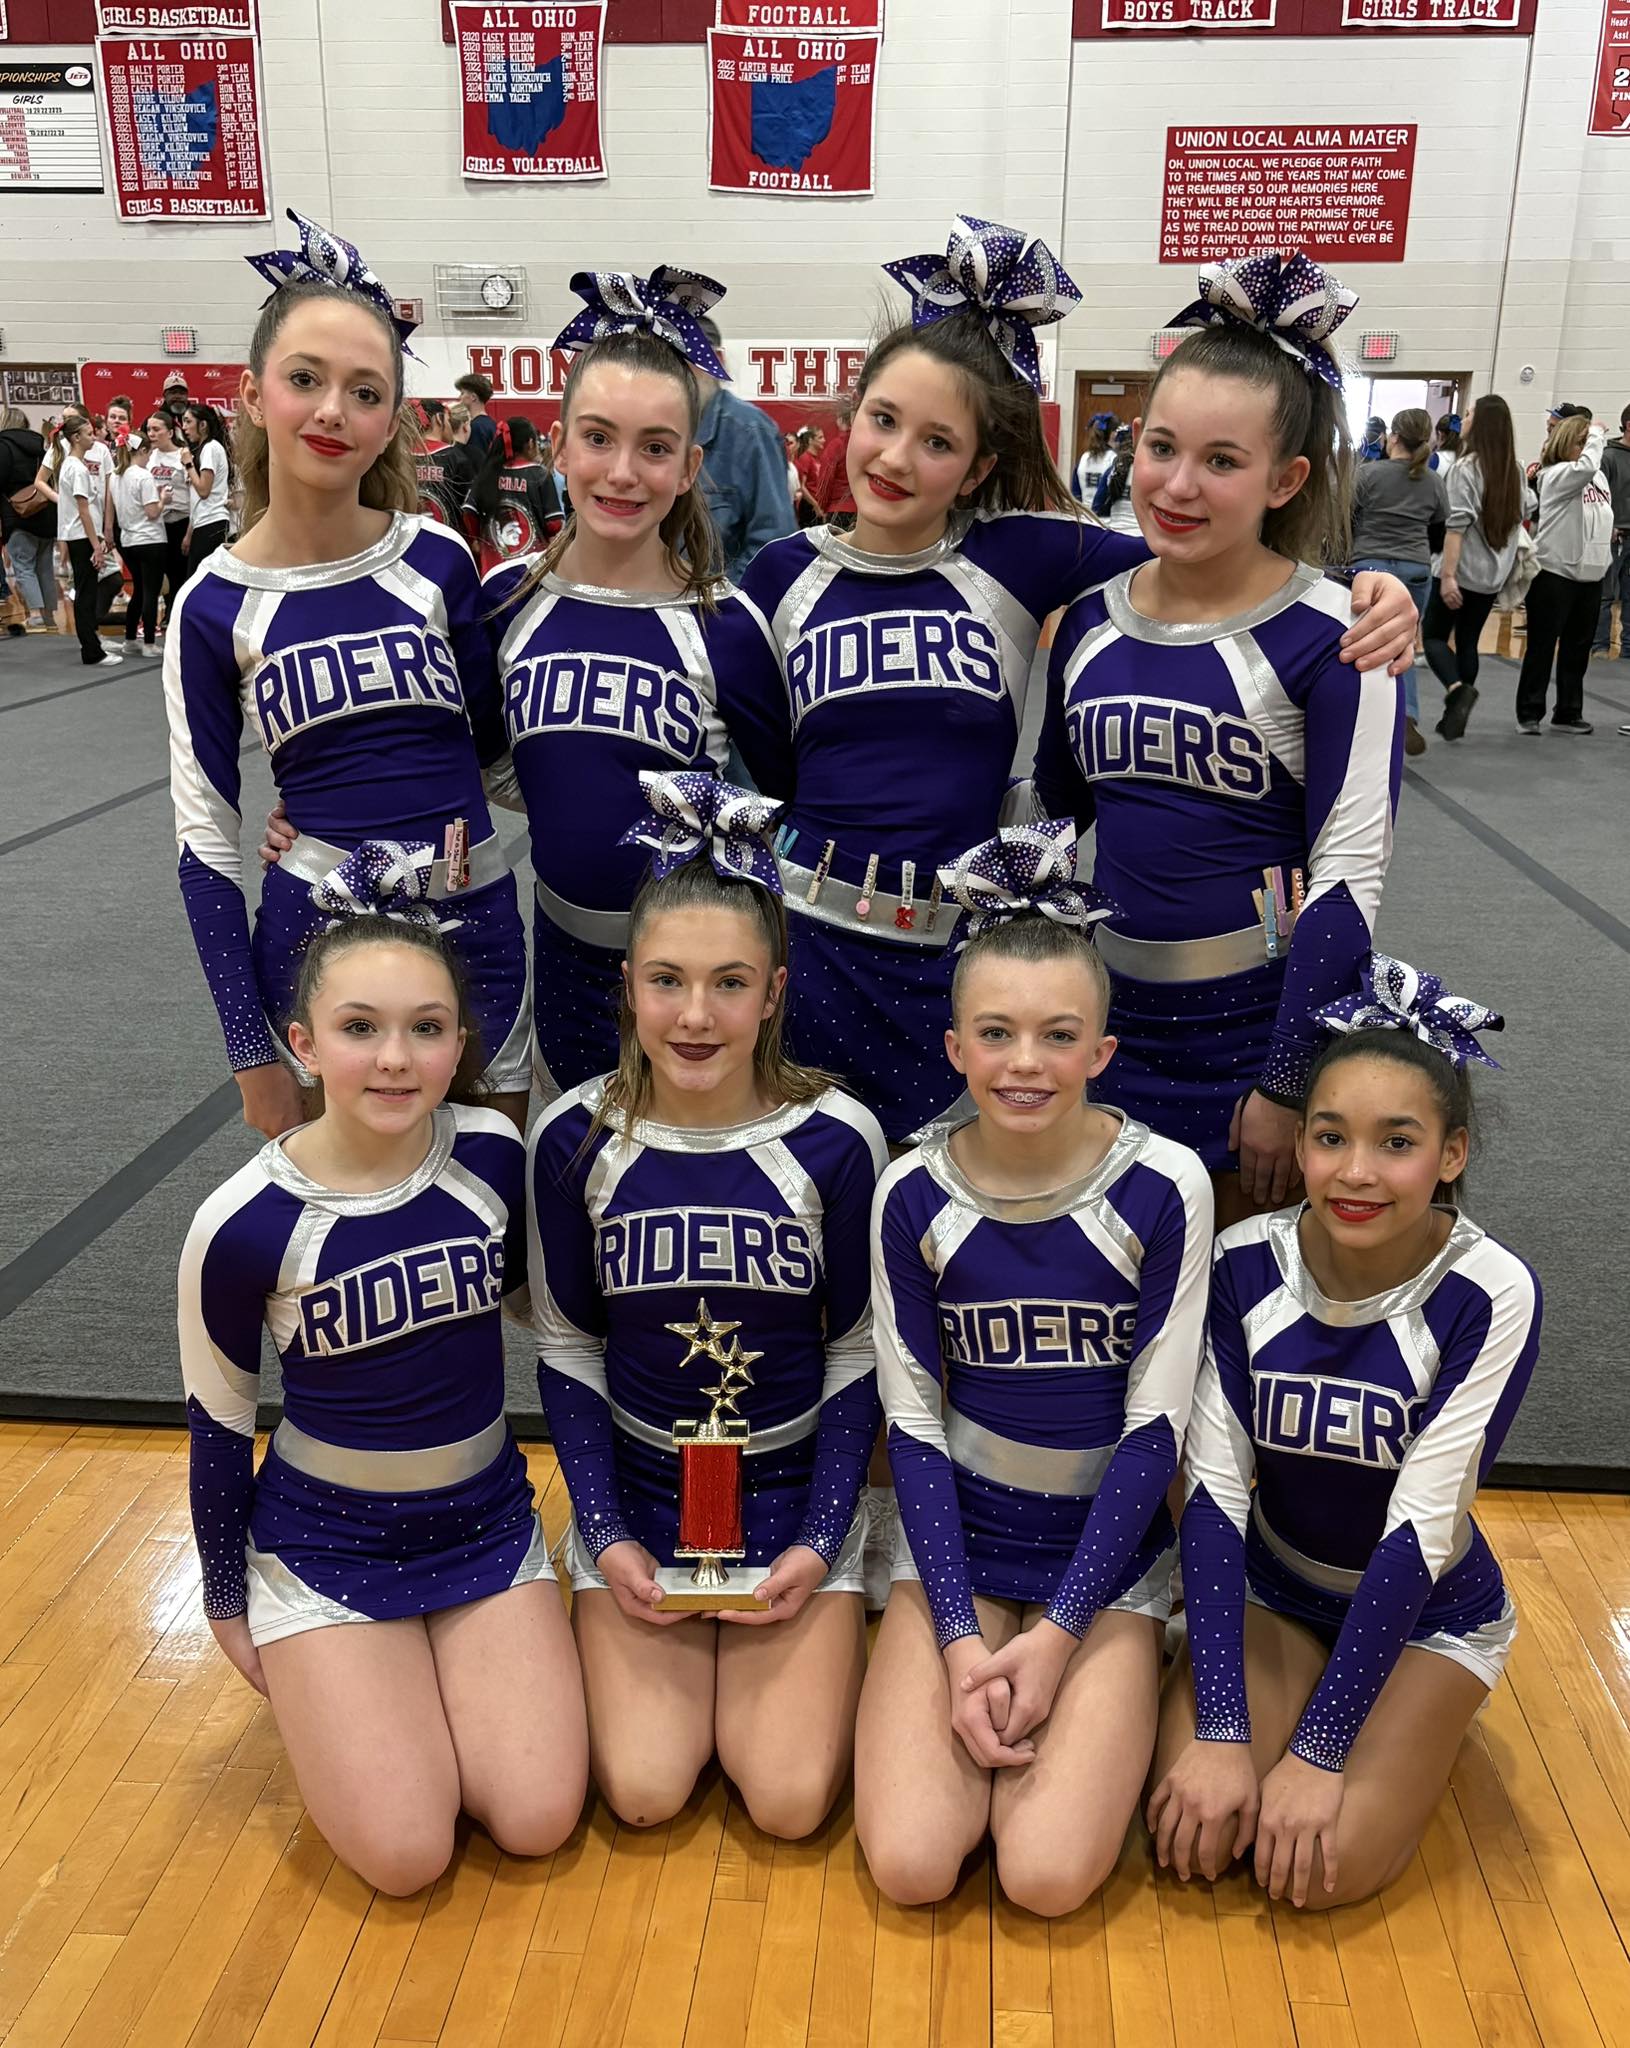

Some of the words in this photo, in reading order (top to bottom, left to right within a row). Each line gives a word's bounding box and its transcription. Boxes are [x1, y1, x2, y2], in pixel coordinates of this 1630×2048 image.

[748, 6, 850, 24] FOOTBALL
[1124, 1, 1173, 20] BOYS
[1190, 0, 1254, 19] TRACK
[1362, 0, 1418, 18] GIRLS
[1430, 0, 1498, 18] TRACK
[101, 8, 145, 27] GIRLS
[149, 7, 249, 27] BASKETBALL
[483, 10, 519, 28] ALL
[532, 9, 576, 27] OHIO
[1611, 18, 1627, 27] Head
[462, 32, 479, 41] 2020
[482, 33, 504, 41] CASEY
[509, 33, 534, 41] KILDOW
[128, 43, 165, 61] ALL
[181, 42, 227, 60] OHIO
[463, 43, 480, 51] 2020
[483, 43, 505, 52] TORRE
[509, 43, 535, 52] KILDOW
[575, 42, 593, 51] TEAM
[743, 39, 782, 58] ALL
[798, 41, 846, 60] OHIO
[464, 53, 479, 62] 2021
[483, 53, 505, 62] TORRE
[510, 53, 535, 62] KILDOW
[575, 52, 593, 61] TEAM
[129, 65, 152, 74] HALEY
[157, 65, 184, 74] PORTER
[229, 64, 249, 72] TEAM
[465, 63, 481, 72] 2022
[484, 63, 506, 72] TORRE
[510, 63, 535, 72] KILDOW
[576, 62, 593, 71] TEAM
[717, 60, 735, 70] 2022
[739, 62, 767, 72] CARTER
[770, 64, 794, 73] BLAKE
[851, 64, 870, 73] TEAM
[0, 72, 62, 83] PIONSHIPS
[466, 73, 482, 82] 2024
[484, 73, 507, 82] LAKEN
[717, 70, 735, 80] 2022
[771, 74, 792, 83] PRICE
[851, 74, 870, 84] TEAM
[466, 83, 483, 92] 2024
[484, 83, 506, 92] OLIVIA
[577, 83, 594, 91] TEAM
[13, 95, 43, 104] GIRLS
[466, 94, 483, 102] 2024
[484, 94, 504, 102] EMMA
[510, 94, 530, 102] YAGER
[578, 92, 595, 101] TEAM
[1175, 131, 1227, 147] UNION
[1233, 131, 1287, 146] LOCAL
[1293, 130, 1342, 146] ALMA
[1349, 130, 1408, 145] MATER
[466, 157, 505, 172] GIRLS
[512, 157, 600, 173] VOLLEYBALL
[1189, 159, 1220, 169] UNION
[1262, 158, 1278, 168] WE
[1282, 158, 1322, 167] PLEDGE
[1326, 158, 1347, 167] OUR
[1351, 157, 1381, 166] FAITH
[749, 171, 832, 189] FOOTBALL
[1168, 173, 1181, 182] TO
[1185, 172, 1203, 181] THE
[1207, 172, 1236, 181] TIMES
[1240, 172, 1261, 181] AND
[1265, 171, 1283, 180] THE
[1287, 171, 1320, 180] YEARS
[1324, 170, 1349, 180] THAT
[1352, 170, 1373, 180] MAY
[1377, 170, 1407, 179] COME.
[143, 181, 168, 190] LAUREN
[172, 181, 199, 190] MILLER
[240, 181, 258, 189] TEAM
[1168, 185, 1184, 194] WE
[1187, 185, 1244, 194] REMEMBER
[1248, 184, 1263, 193] SO
[1267, 184, 1288, 193] OUR
[1292, 183, 1347, 193] MEMORIES
[1351, 183, 1378, 192] HERE
[127, 199, 163, 214] GIRLS
[171, 199, 258, 213] BASKETBALL
[1167, 198, 1193, 207] THEY
[1197, 197, 1221, 207] WILL
[1225, 197, 1238, 206] BE
[1242, 197, 1251, 206] IN
[1255, 197, 1276, 206] OUR
[1280, 196, 1322, 206] HEARTS
[1326, 196, 1385, 205] EVERMORE.
[1166, 210, 1179, 219] TO
[1183, 210, 1209, 219] THEE
[1213, 210, 1229, 219] WE
[1233, 209, 1272, 219] PLEDGE
[1276, 209, 1297, 218] OUR
[1301, 208, 1348, 218] PROMISE
[1351, 208, 1379, 217] TRUE
[1165, 223, 1180, 232] AS
[1184, 223, 1200, 232] WE
[1204, 222, 1238, 231] TREAD
[1242, 222, 1274, 231] DOWN
[1278, 222, 1297, 231] THE
[1301, 221, 1349, 230] PATHWAY
[1353, 221, 1367, 230] OF
[1371, 221, 1394, 230] LIFE.
[1183, 235, 1198, 244] SO
[1201, 235, 1249, 244] FAITHFUL
[1253, 234, 1275, 244] AND
[1315, 234, 1344, 243] WE'LL
[1349, 234, 1376, 243] EVER
[1380, 233, 1393, 243] BE
[1163, 247, 1178, 256] AS
[1182, 247, 1198, 256] WE
[1202, 247, 1228, 256] STEP
[1232, 247, 1245, 256] TO
[748, 347, 868, 397] THE
[785, 609, 1007, 728] RIDERS
[254, 624, 465, 753] RIDERS
[502, 651, 706, 764] RIDERS
[1065, 695, 1271, 800] RIDERS
[596, 1207, 816, 1293] RIDERS
[938, 1299, 1138, 1368] RIDERS
[1251, 1370, 1428, 1469] IDER
